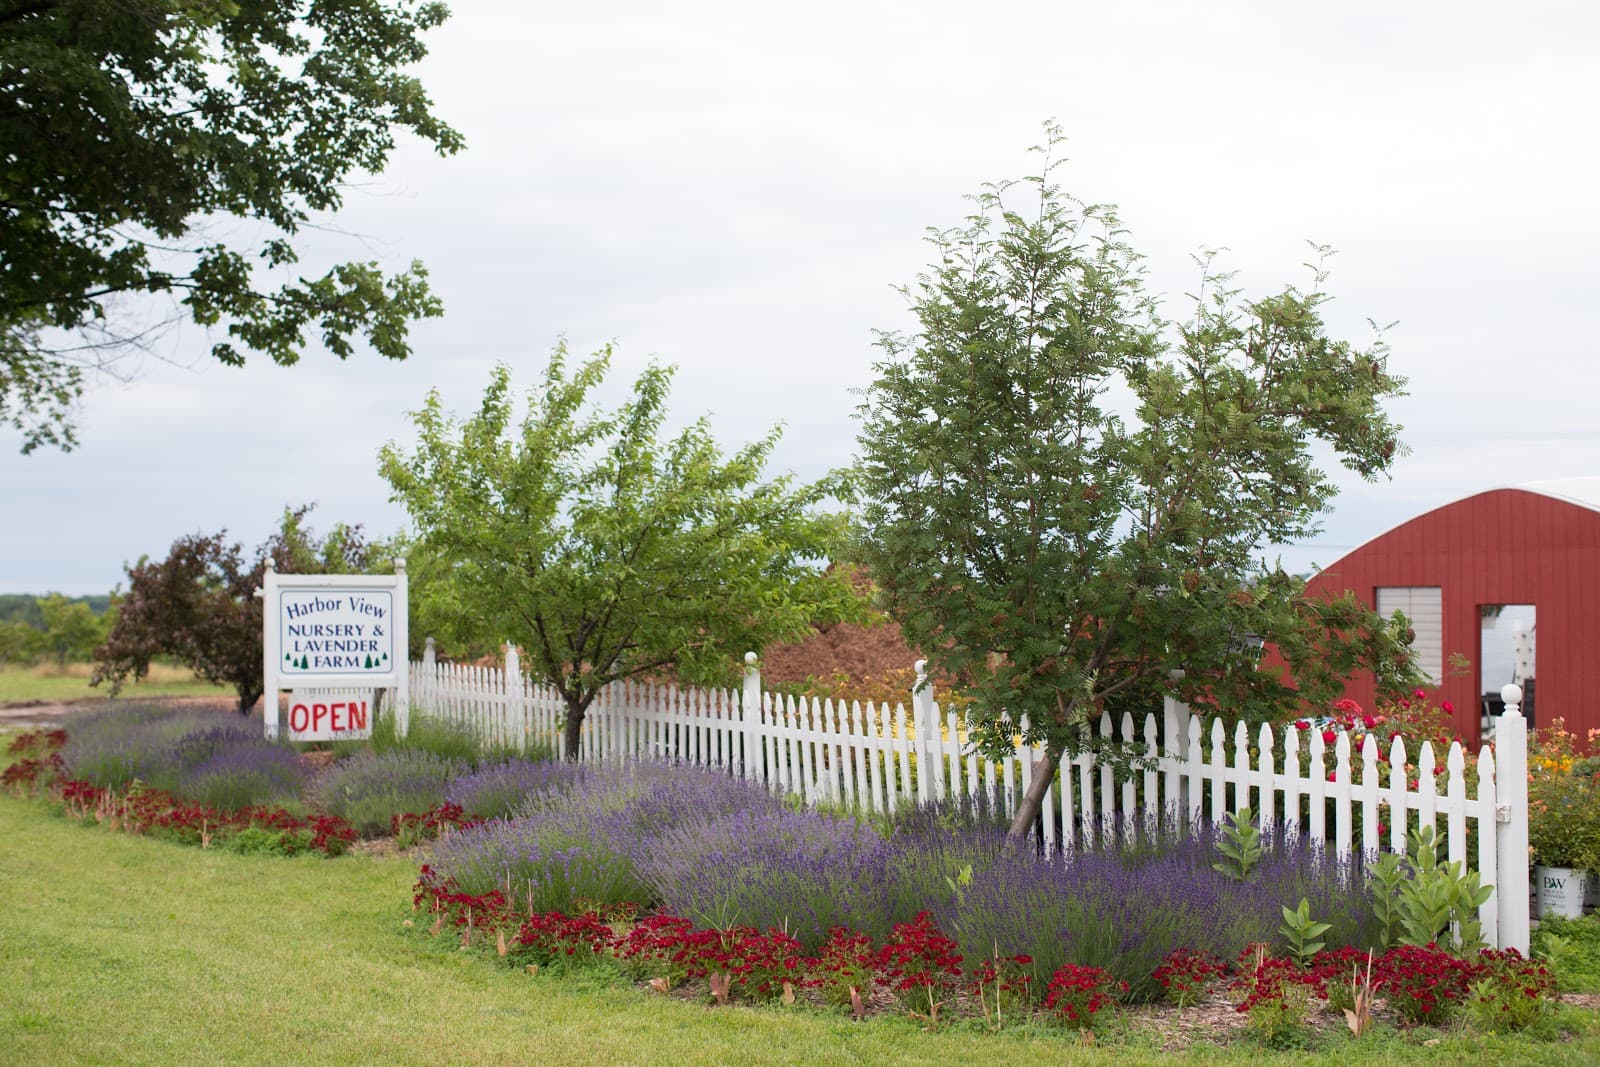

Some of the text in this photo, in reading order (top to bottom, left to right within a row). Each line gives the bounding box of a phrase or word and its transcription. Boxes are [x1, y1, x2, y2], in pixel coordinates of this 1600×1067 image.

[286, 597, 386, 619] Harbor View
[288, 624, 384, 637] NURSERY &
[294, 639, 378, 652] LAVENDER
[314, 655, 360, 668] FARM
[290, 701, 367, 733] OPEN
